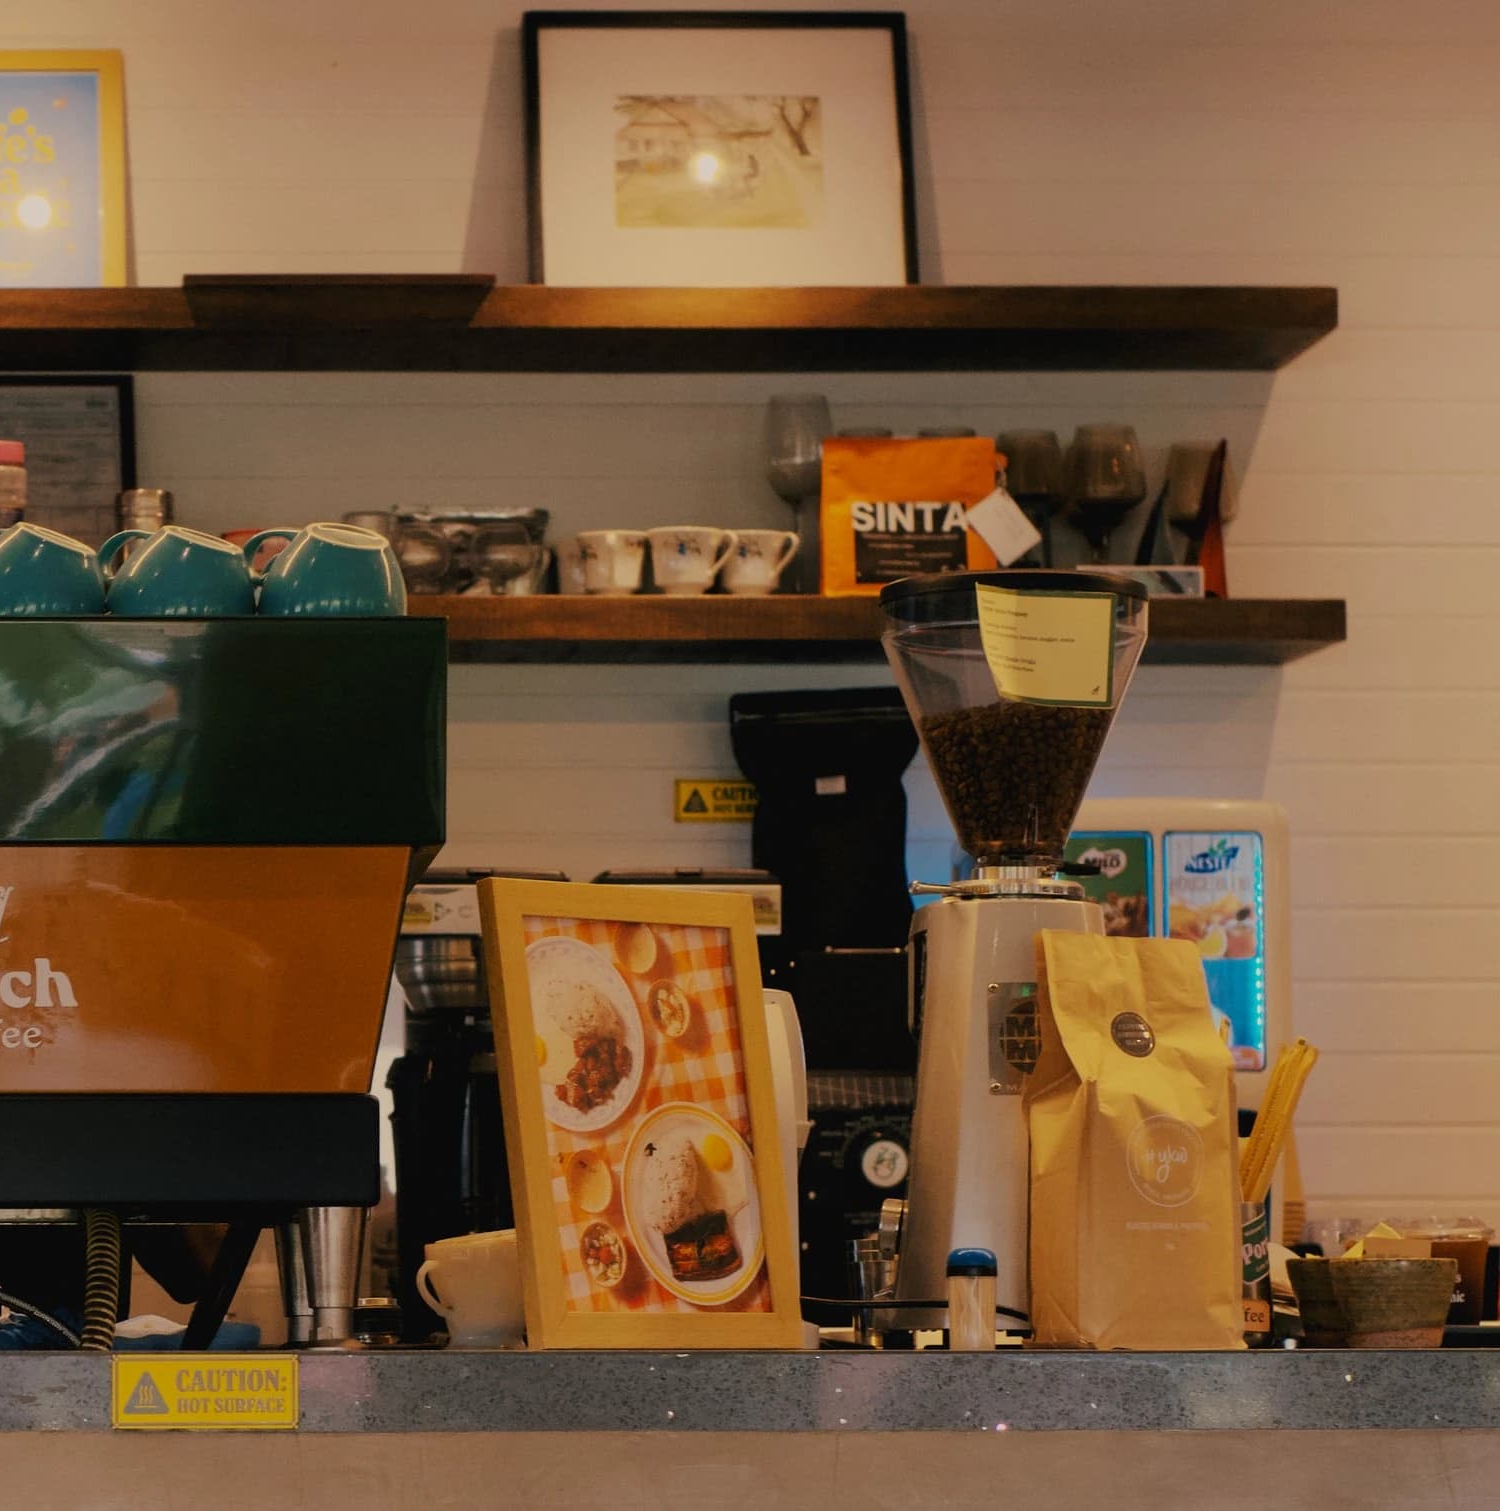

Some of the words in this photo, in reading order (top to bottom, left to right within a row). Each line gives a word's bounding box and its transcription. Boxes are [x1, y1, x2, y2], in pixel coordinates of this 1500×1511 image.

[852, 501, 967, 533] SINTA
[175, 1369, 288, 1393] CAUTION:
[177, 1398, 211, 1414] HOT
[214, 1398, 286, 1414] SURFACE
